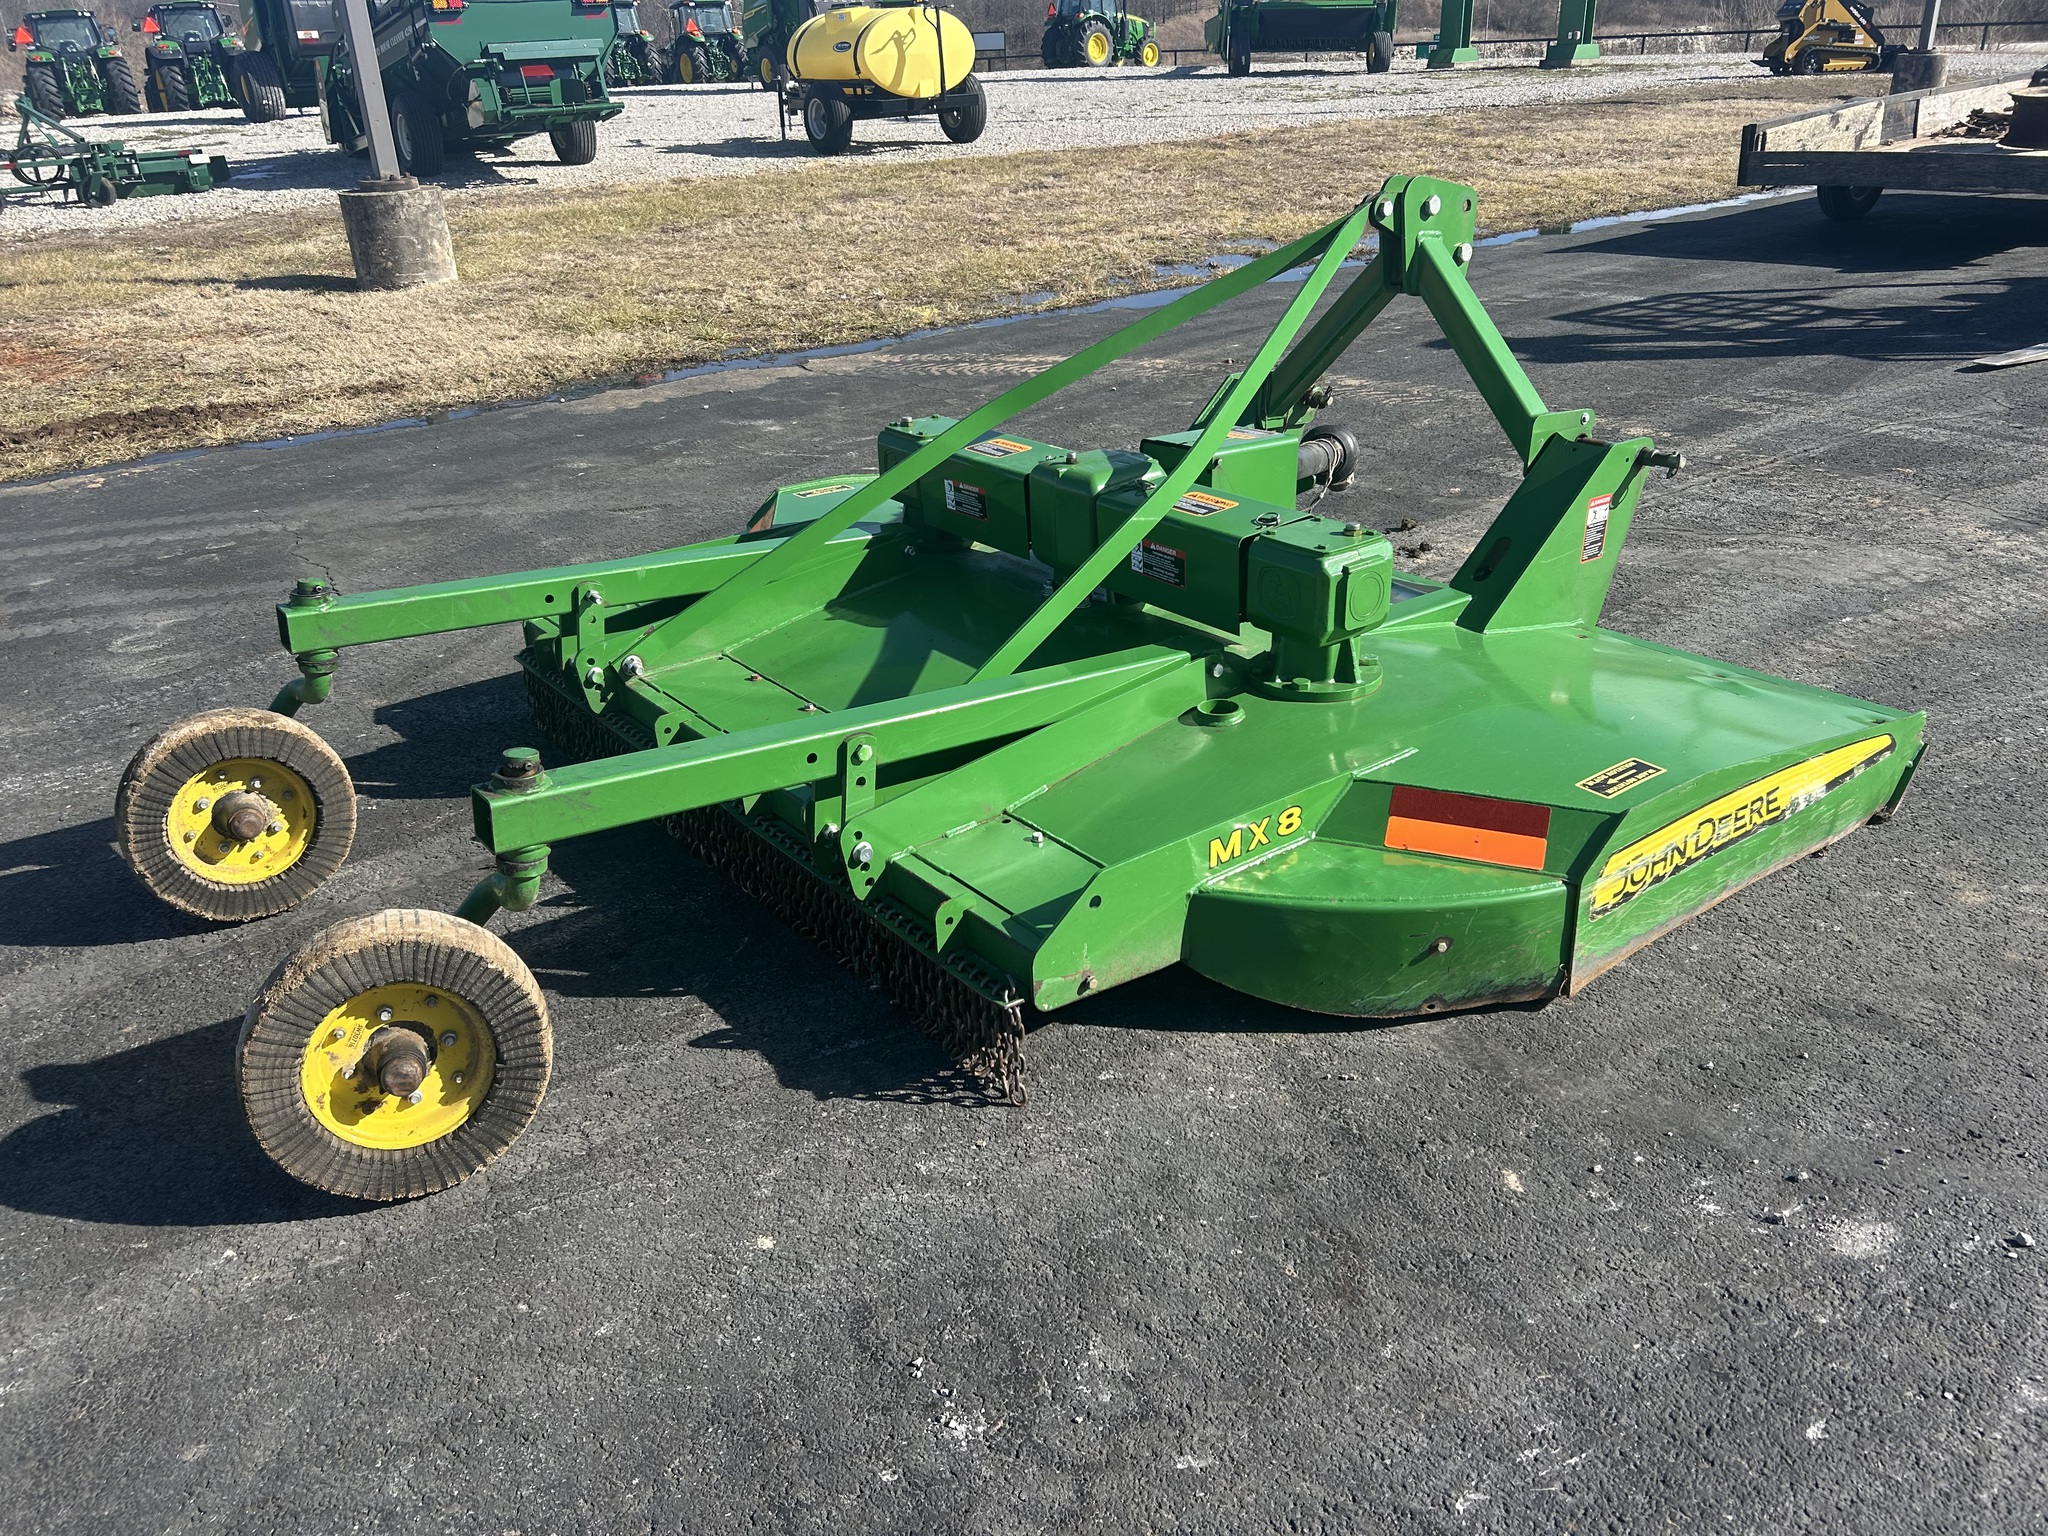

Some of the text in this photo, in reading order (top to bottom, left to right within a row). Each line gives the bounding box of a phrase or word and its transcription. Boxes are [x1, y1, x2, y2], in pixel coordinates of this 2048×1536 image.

[963, 484, 980, 493] DANGER
[1155, 544, 1177, 556] DANGER
[1585, 761, 1637, 786] BLADE ROTATION
[1612, 786, 1781, 899] JOHN DEERE
